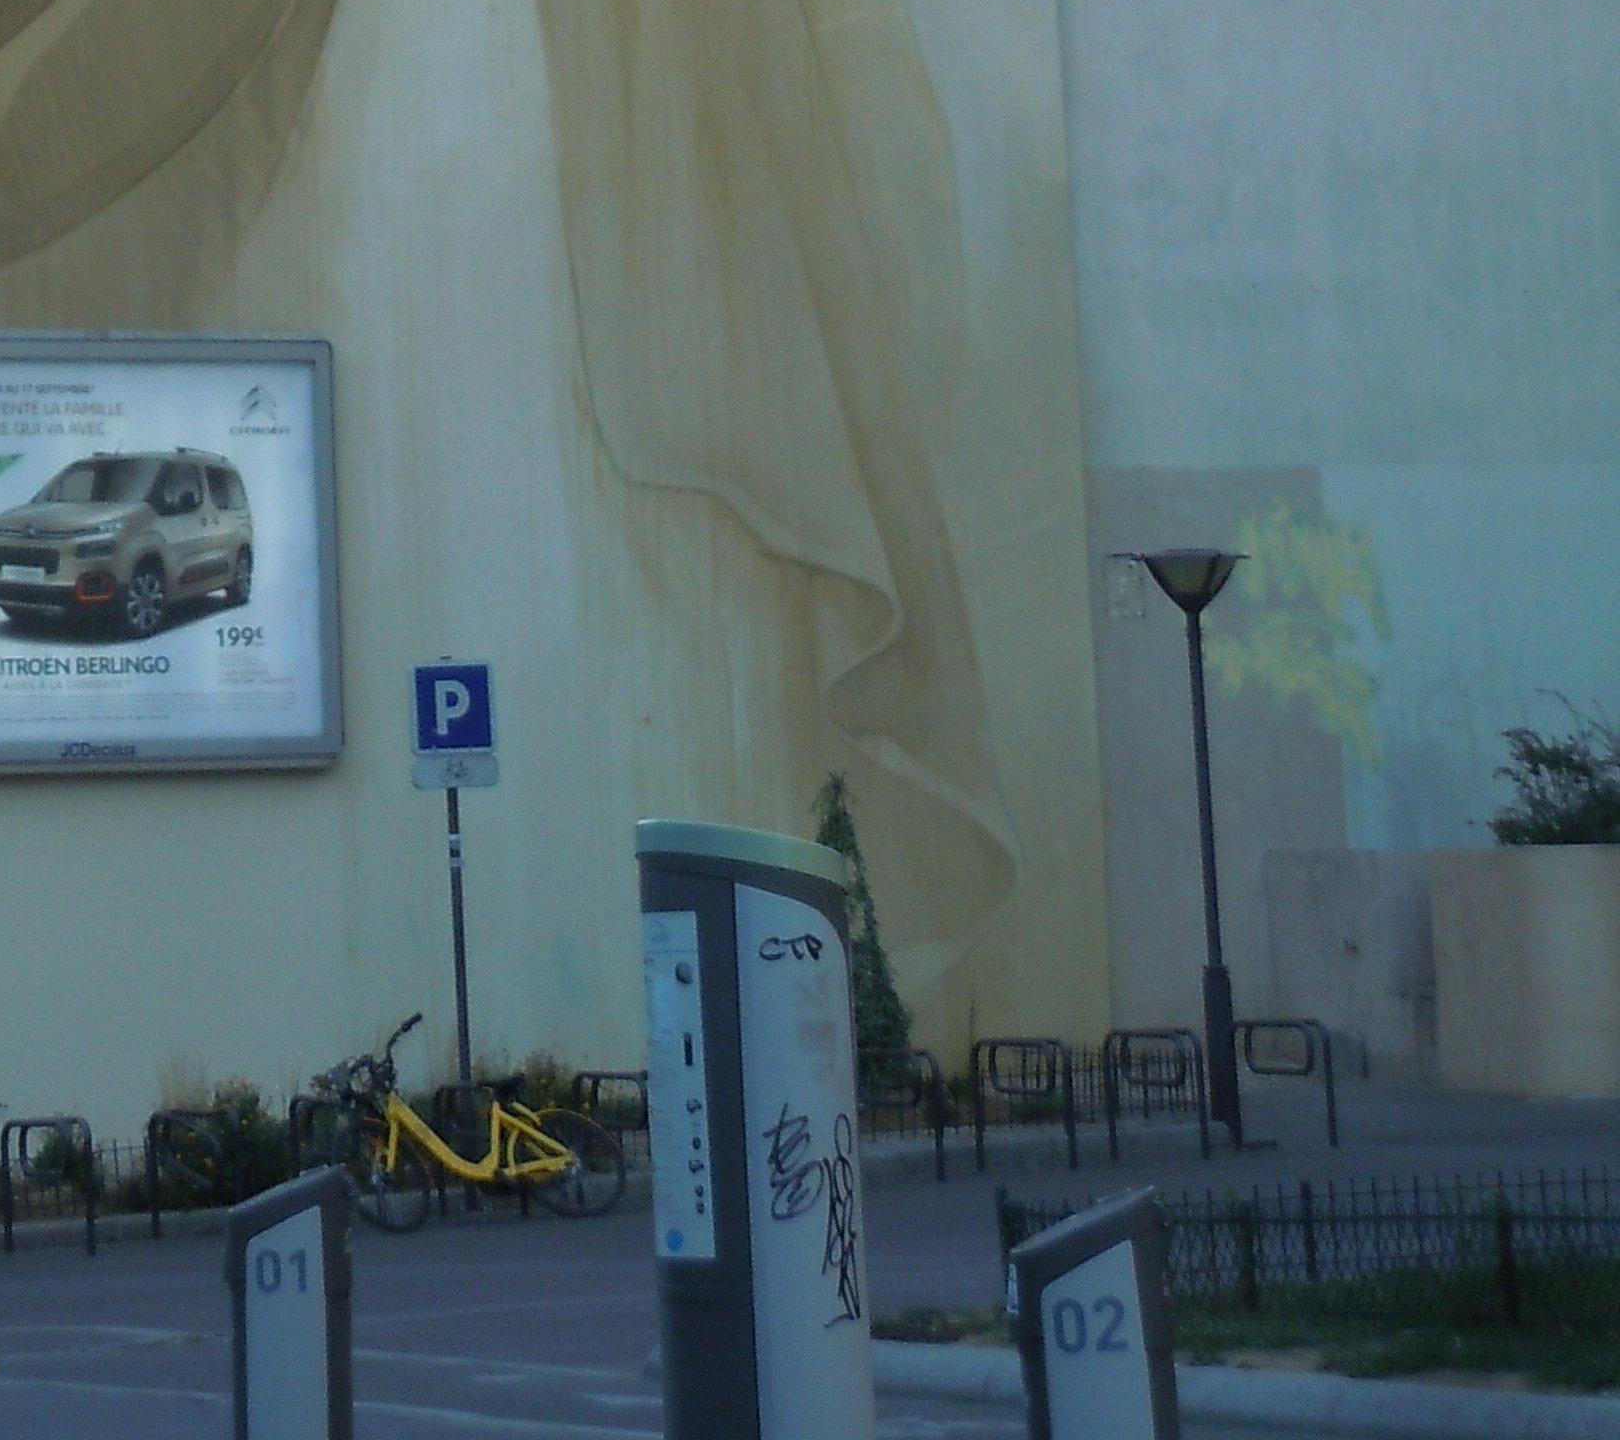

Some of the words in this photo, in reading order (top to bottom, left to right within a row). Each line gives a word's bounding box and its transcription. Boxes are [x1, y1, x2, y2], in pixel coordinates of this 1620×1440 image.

[75, 655, 171, 675] BERLINGO
[435, 679, 470, 736] P
[255, 1248, 307, 1293] 01
[1053, 1296, 1129, 1353] 02
